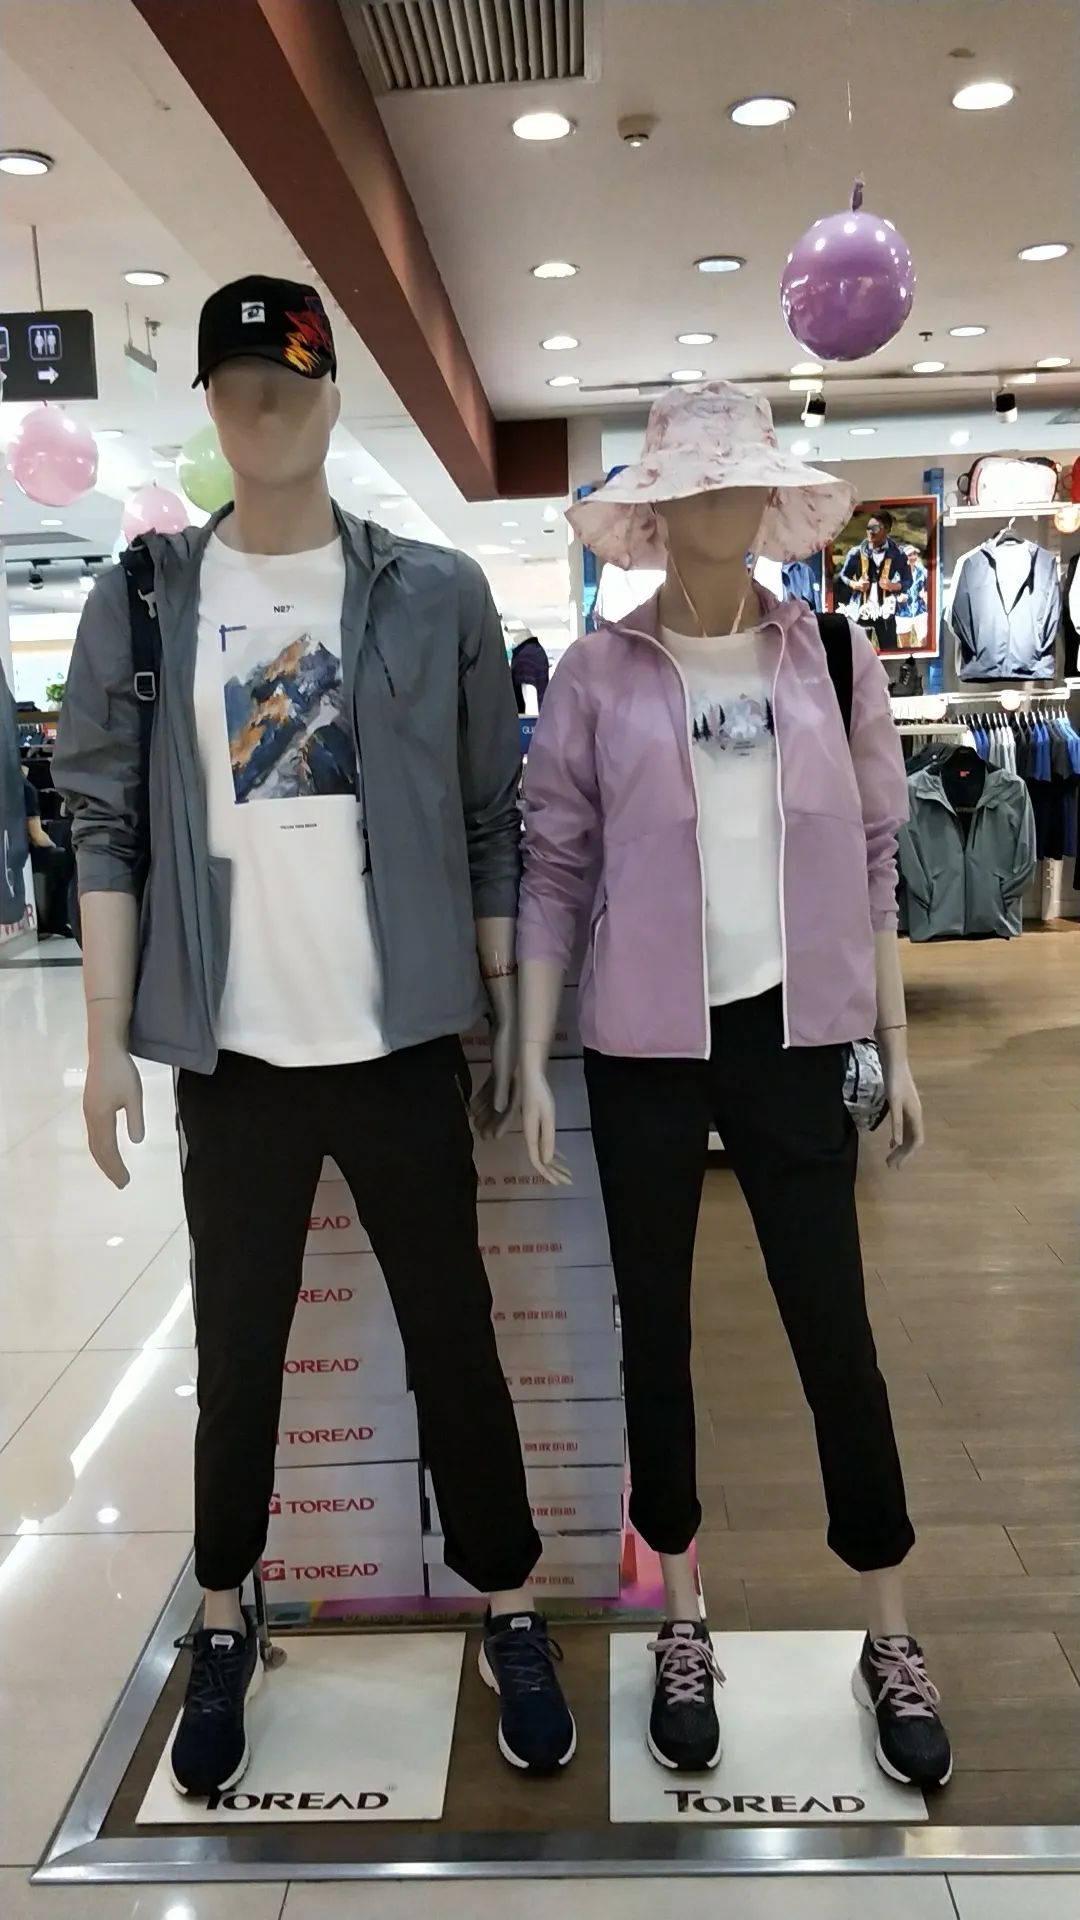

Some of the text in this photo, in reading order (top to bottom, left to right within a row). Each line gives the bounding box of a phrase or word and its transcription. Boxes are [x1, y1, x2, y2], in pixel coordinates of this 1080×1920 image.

[283, 1358, 359, 1374] OREAD
[285, 1426, 374, 1445] TOREAD
[286, 1497, 375, 1514] TOREAD
[290, 1562, 379, 1580] TOREAD
[664, 1790, 866, 1813] TOREAD
